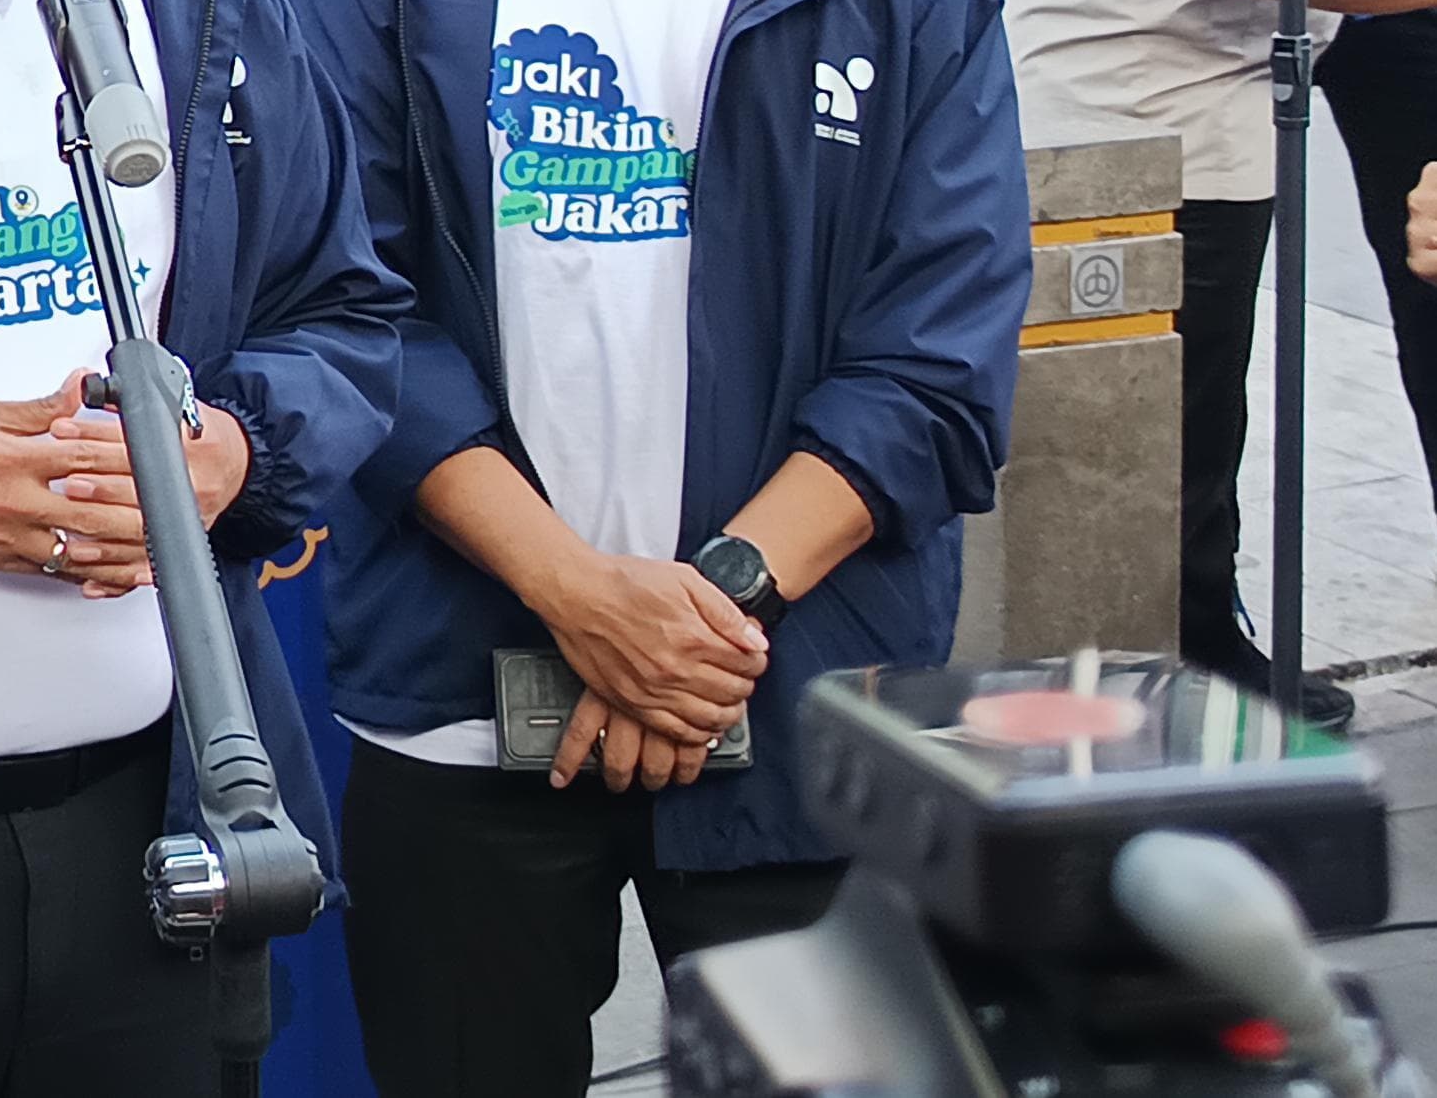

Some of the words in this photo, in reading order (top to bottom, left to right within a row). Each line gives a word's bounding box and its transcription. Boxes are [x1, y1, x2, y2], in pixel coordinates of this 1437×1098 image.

[529, 104, 656, 153] Bikin
[504, 149, 696, 193] Gampan
[535, 192, 692, 235] Jakar
